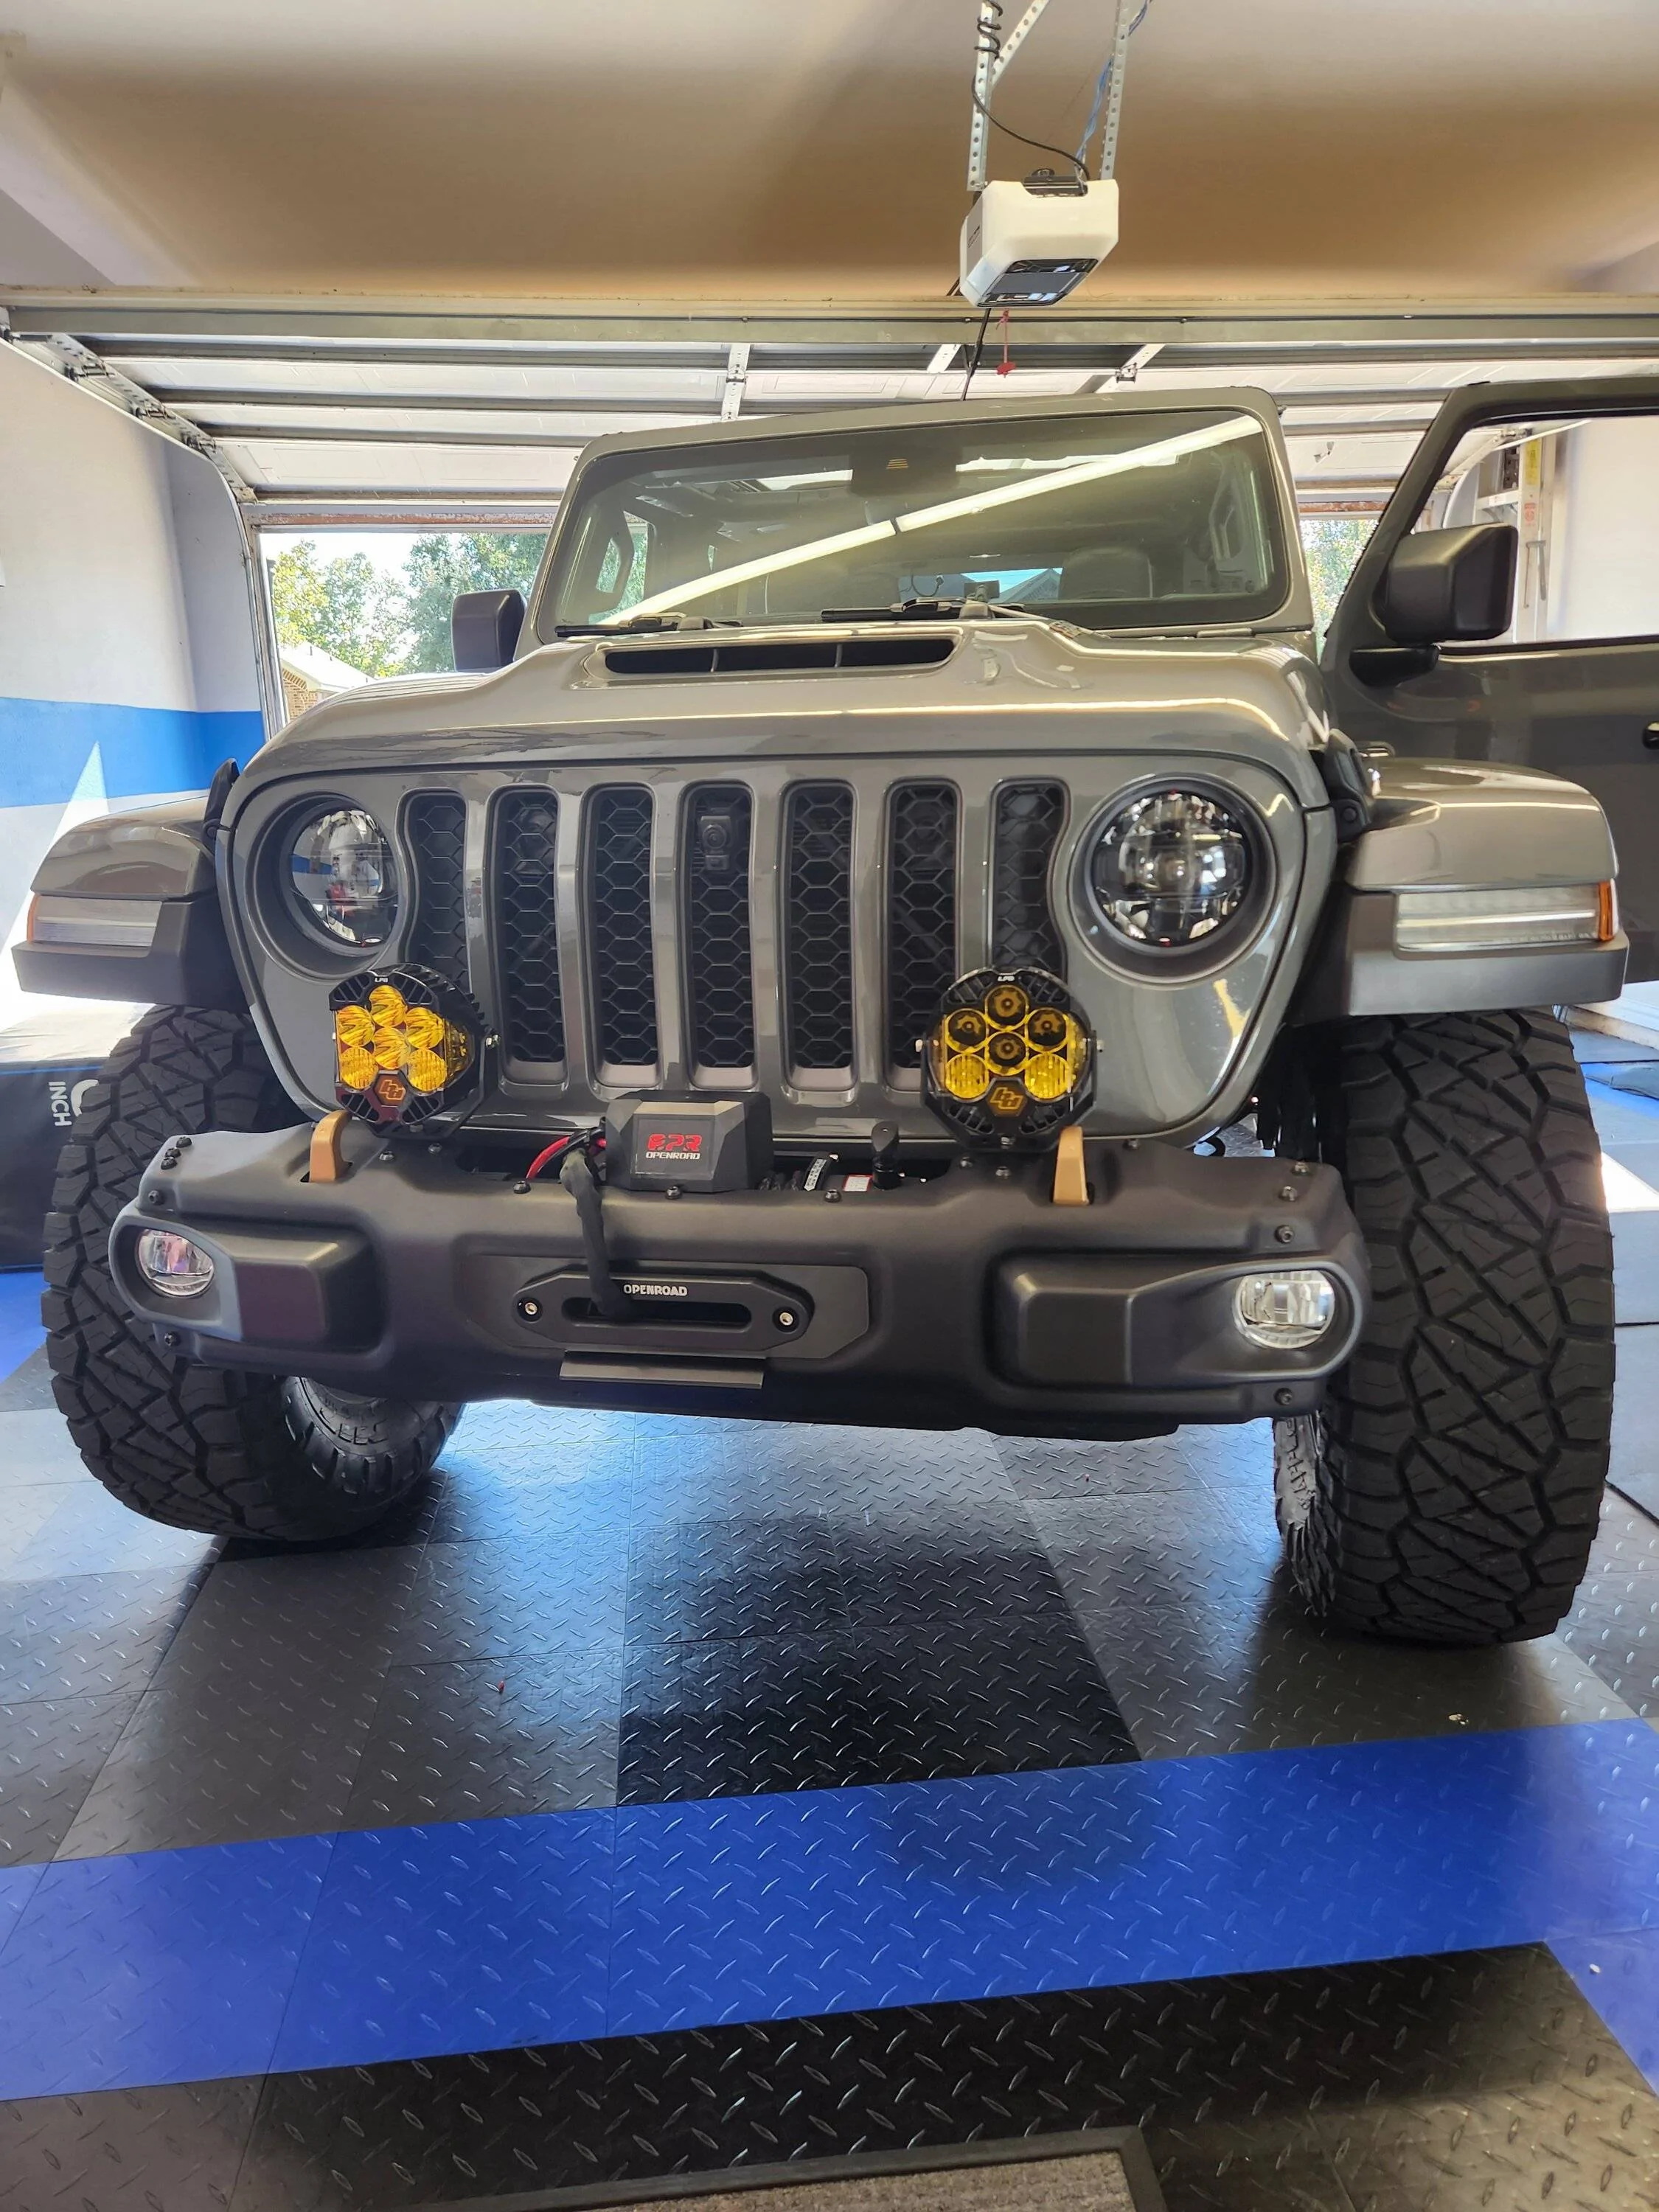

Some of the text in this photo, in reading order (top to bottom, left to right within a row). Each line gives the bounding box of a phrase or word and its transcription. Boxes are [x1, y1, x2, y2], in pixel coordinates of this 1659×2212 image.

[48, 1081, 72, 1127] INCH
[645, 1151, 700, 1160] OPENROAD
[623, 1284, 688, 1297] OPENROAD
